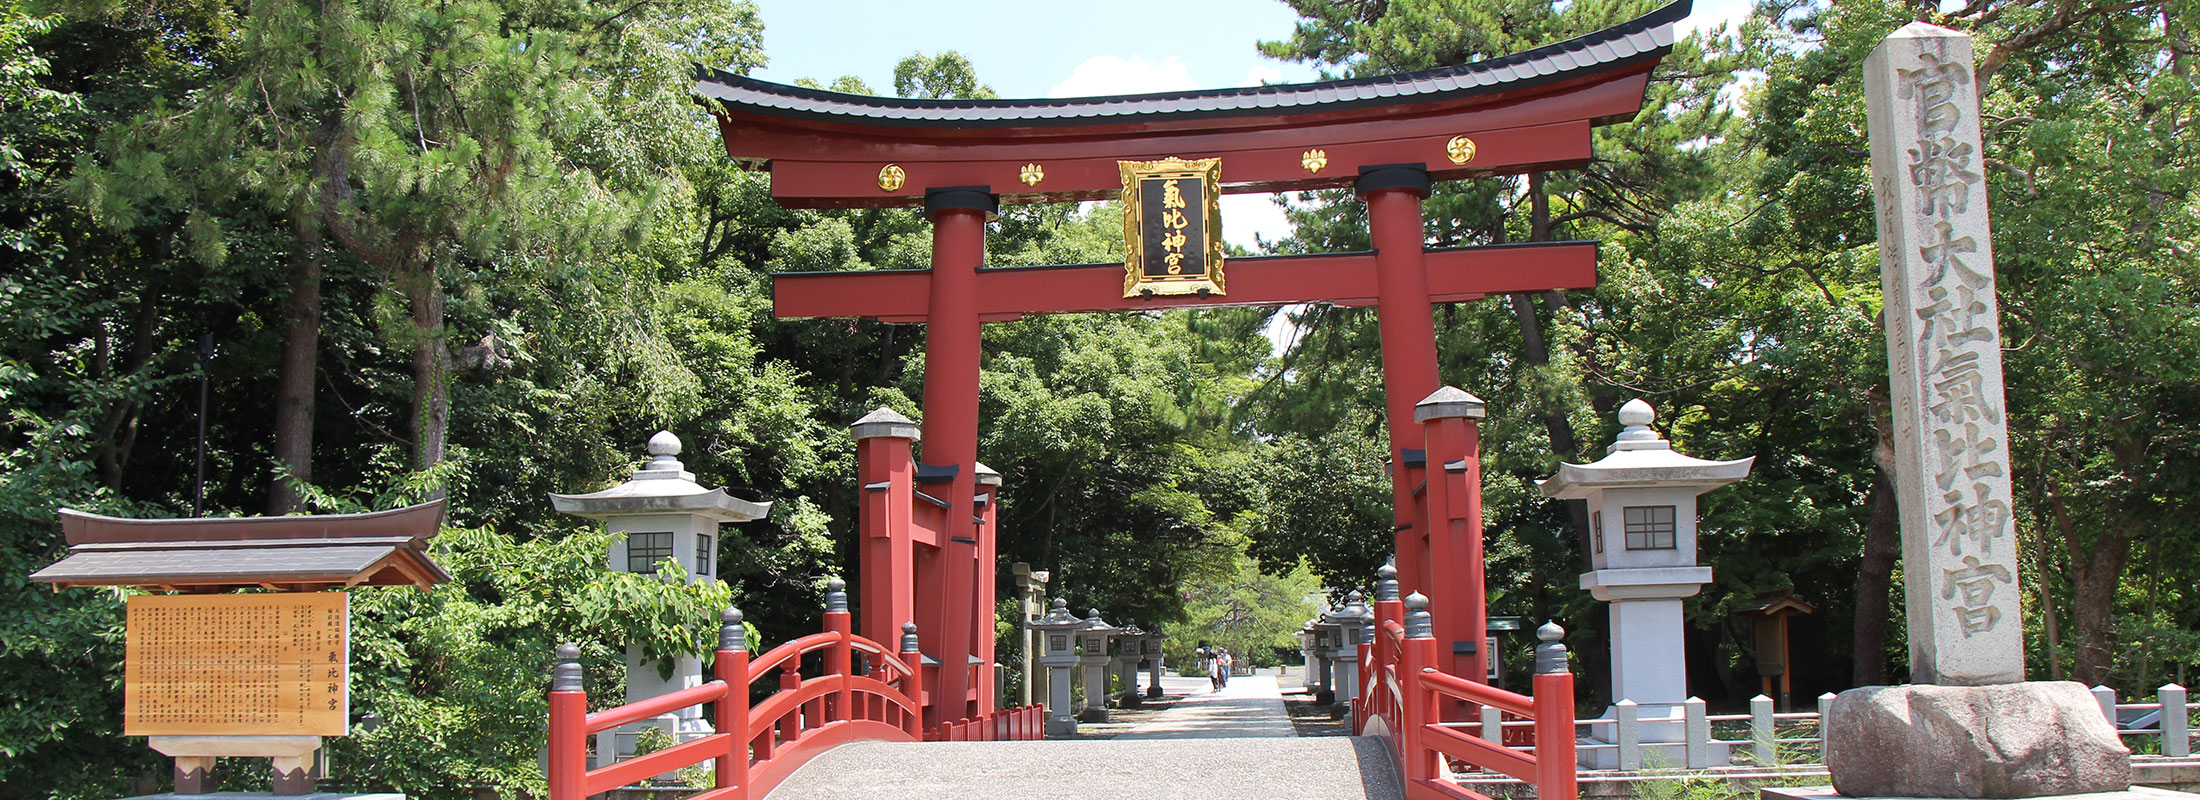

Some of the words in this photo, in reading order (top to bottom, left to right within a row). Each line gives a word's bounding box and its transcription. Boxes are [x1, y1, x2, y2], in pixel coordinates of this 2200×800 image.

[1161, 179, 1189, 275] 氣比神宮
[1896, 53, 2013, 640] 官幣大社氣比神宮
[327, 651, 338, 710] 氣比神宮
